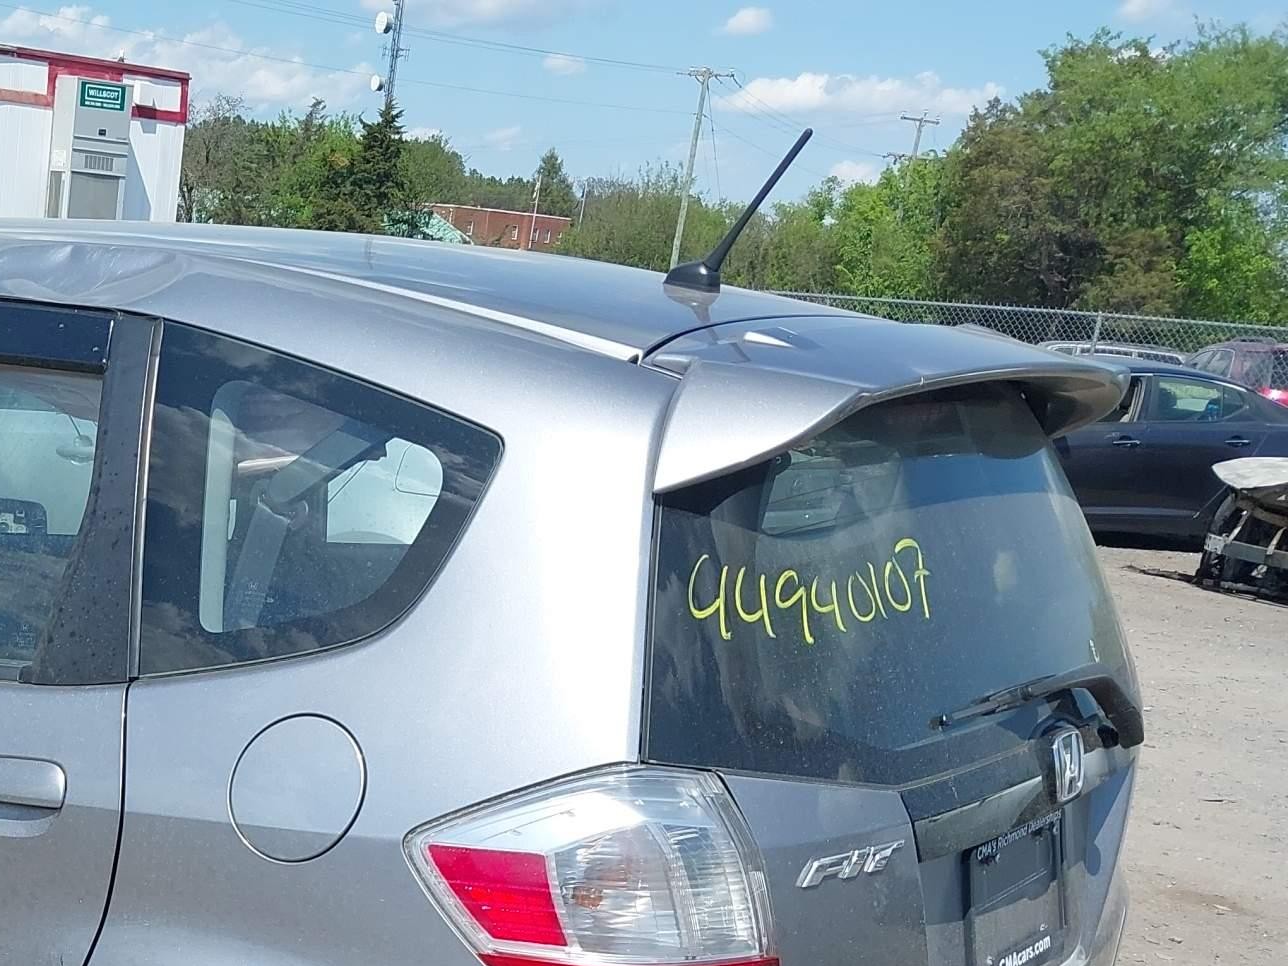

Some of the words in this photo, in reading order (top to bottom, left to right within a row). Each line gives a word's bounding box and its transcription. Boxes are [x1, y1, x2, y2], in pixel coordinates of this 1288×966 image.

[88, 88, 119, 100] WILLSCOT
[688, 538, 931, 645] 44940107
[977, 838, 997, 861] CMA's
[998, 823, 1028, 850] Richmond
[1028, 809, 1062, 834] Dealerships
